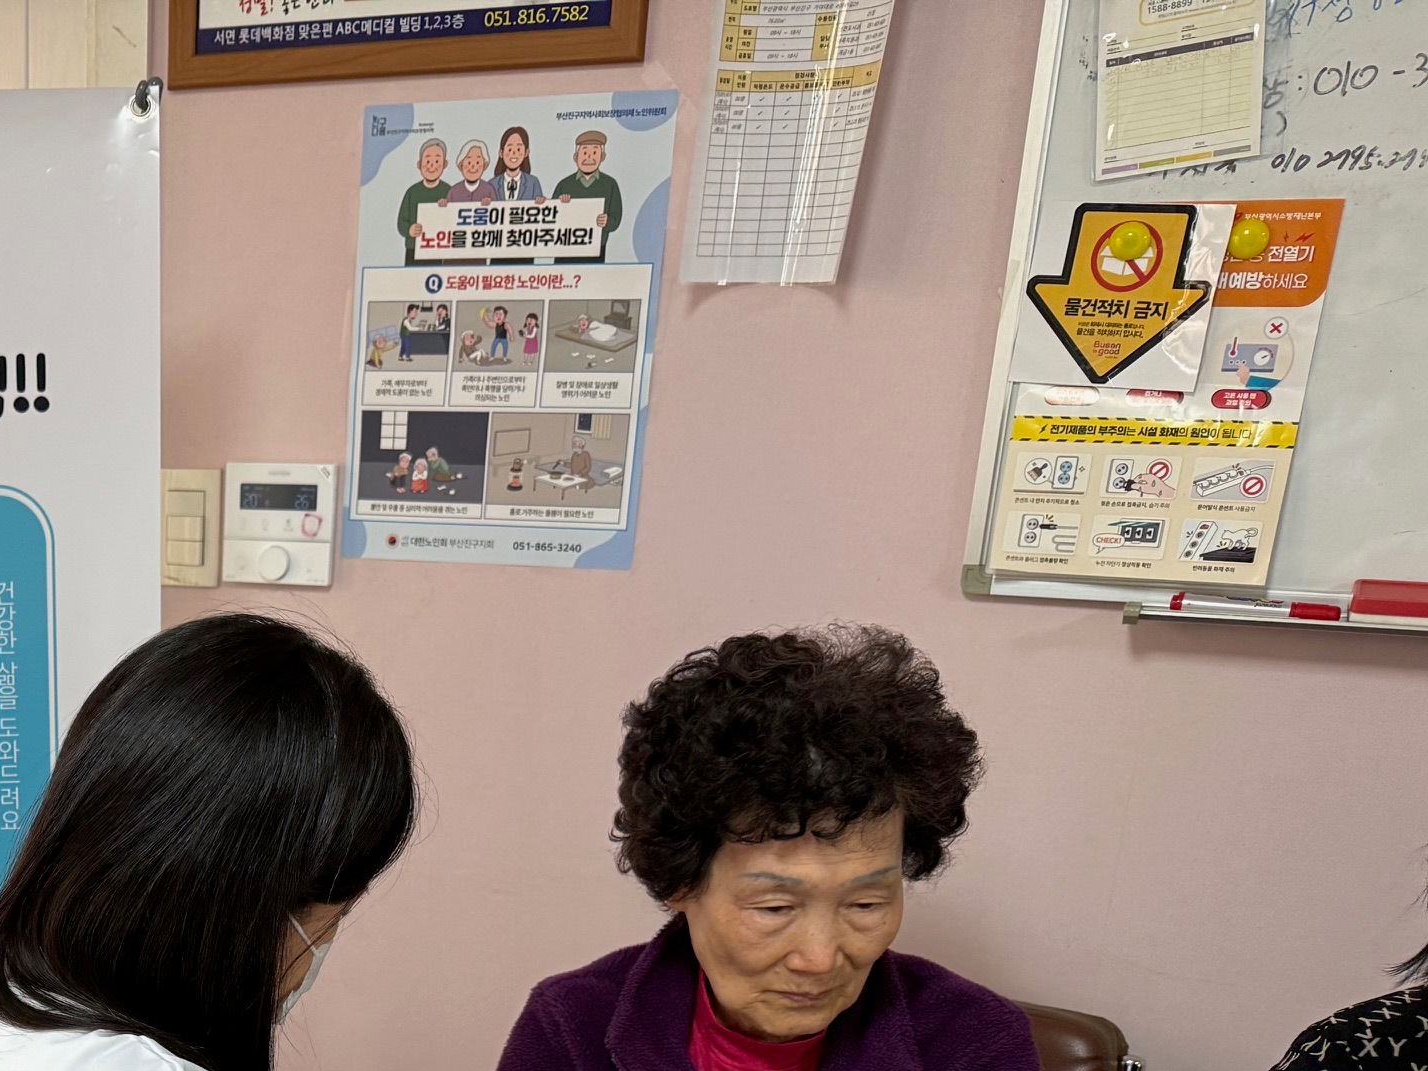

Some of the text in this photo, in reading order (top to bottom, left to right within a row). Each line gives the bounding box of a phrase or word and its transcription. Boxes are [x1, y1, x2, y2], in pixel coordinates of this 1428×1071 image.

[1147, 0, 1193, 14] 1588-8899
[484, 5, 590, 28] 051.816.7582
[214, 13, 465, 46] 서면 롯데백화점 맞은편 ABC메디컬 빌딩 1,2,3층
[1271, 147, 1308, 174] 010
[456, 205, 557, 226] 도움이 필요한
[420, 226, 593, 249] 노인을 함께 찾아주세요!
[1267, 245, 1315, 262] 전열기
[445, 275, 479, 290] 도움이
[481, 274, 514, 290] 필요한
[1063, 297, 1169, 321] 물건적치 금지
[1076, 328, 1095, 336] 물건을
[1093, 341, 1121, 349] Busan
[1098, 347, 1120, 357] good
[1050, 424, 1097, 436] 전기제품의
[1098, 425, 1136, 437] 부주의는
[1138, 426, 1157, 437] 시설
[1159, 427, 1188, 438] 화재의
[1190, 428, 1220, 440] 원인이
[513, 541, 582, 553] 051-865-3240
[1096, 536, 1122, 545] CHECK!
